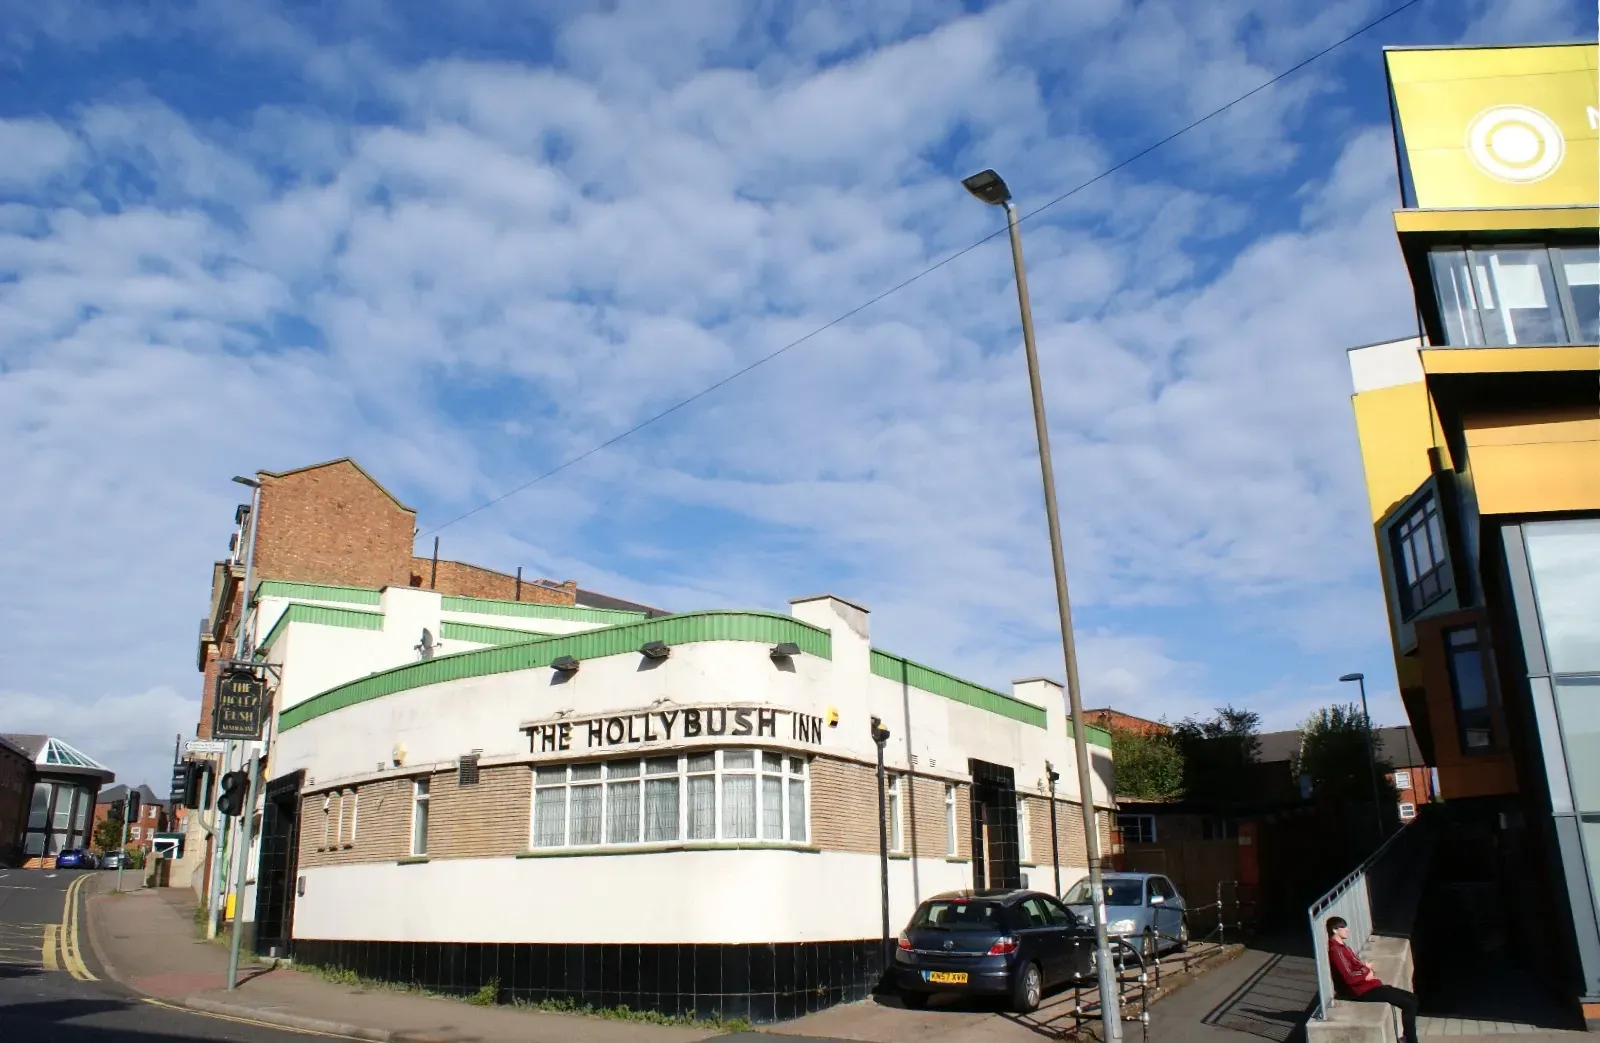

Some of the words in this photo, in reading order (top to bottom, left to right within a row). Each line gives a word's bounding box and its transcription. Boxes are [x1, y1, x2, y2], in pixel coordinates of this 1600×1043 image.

[232, 682, 252, 693] THE
[526, 722, 571, 753] THE
[588, 708, 776, 747] HOLLYBUSH
[791, 711, 823, 745] INN
[931, 972, 949, 981] KN57
[951, 973, 967, 982] XVR
